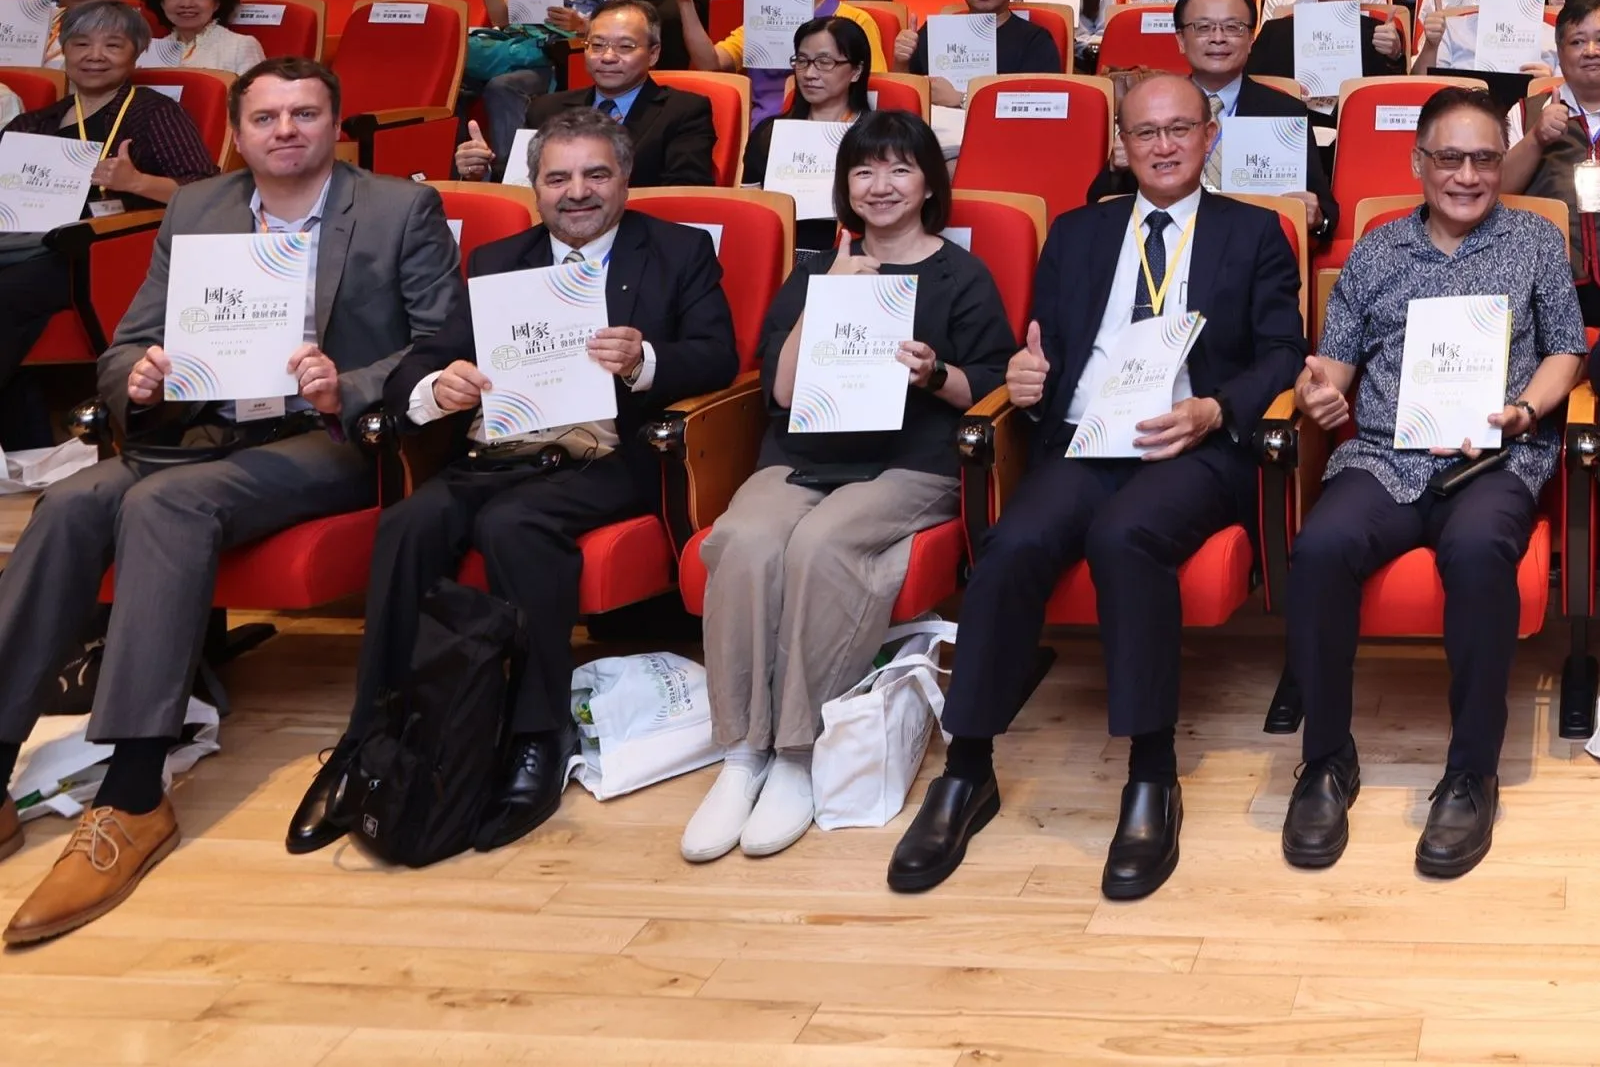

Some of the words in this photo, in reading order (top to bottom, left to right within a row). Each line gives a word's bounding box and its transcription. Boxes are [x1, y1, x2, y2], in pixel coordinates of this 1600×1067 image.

[204, 287, 244, 306] 國家
[512, 322, 550, 341] 國家
[834, 322, 867, 342] 國家
[1431, 342, 1461, 360] 國家
